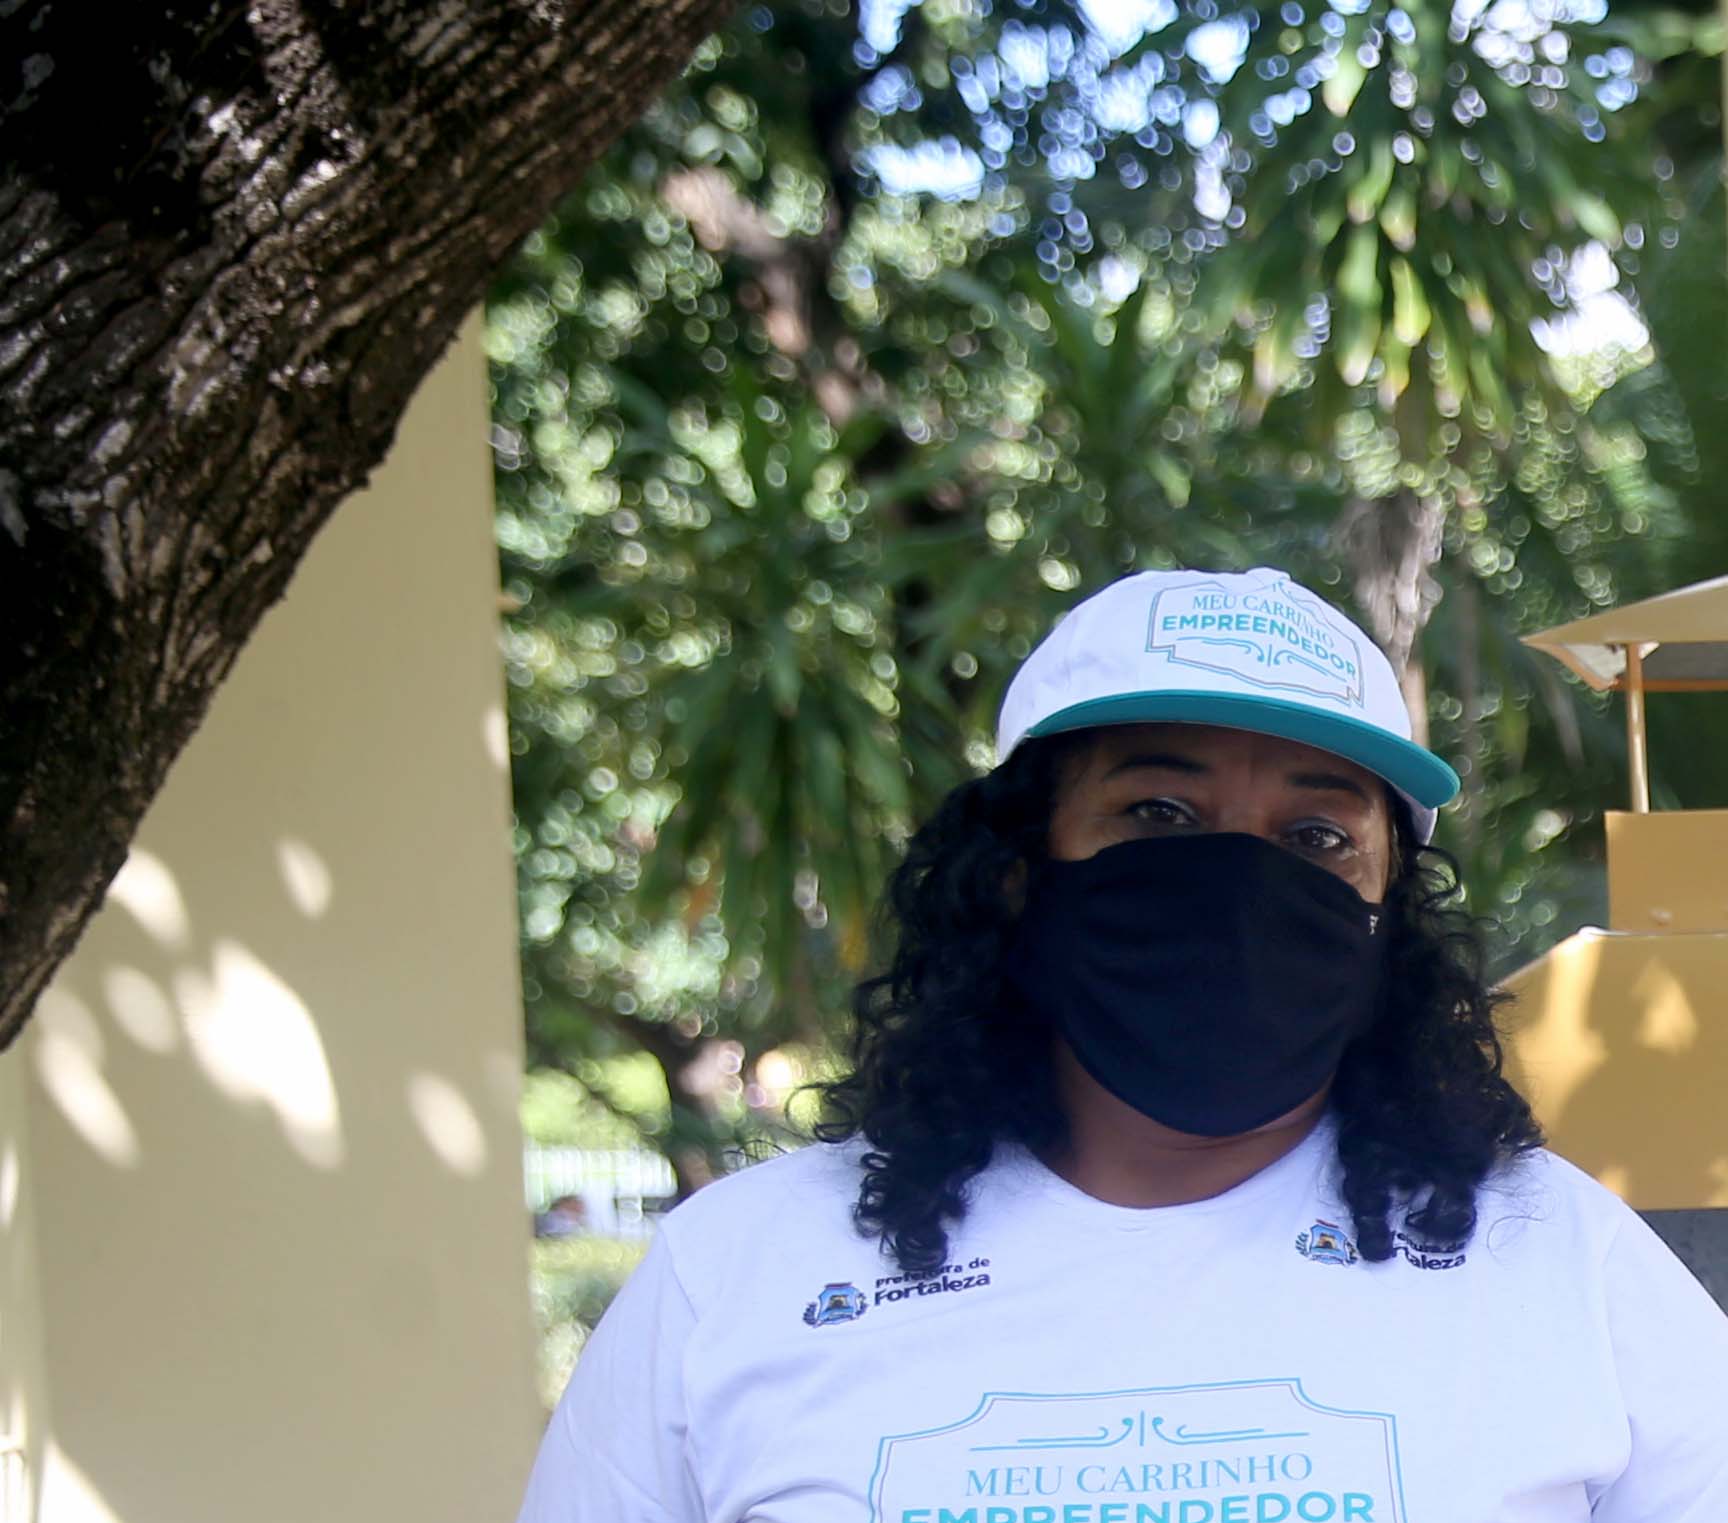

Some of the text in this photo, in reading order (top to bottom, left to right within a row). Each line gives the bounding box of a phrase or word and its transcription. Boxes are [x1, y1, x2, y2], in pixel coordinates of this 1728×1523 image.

[1193, 595, 1237, 611] MEU
[1162, 614, 1357, 680] EMPREENDEDOR
[968, 1257, 991, 1270] de
[874, 1273, 991, 1306] Fortaleza
[964, 1452, 1313, 1497] MEU CARRINHO
